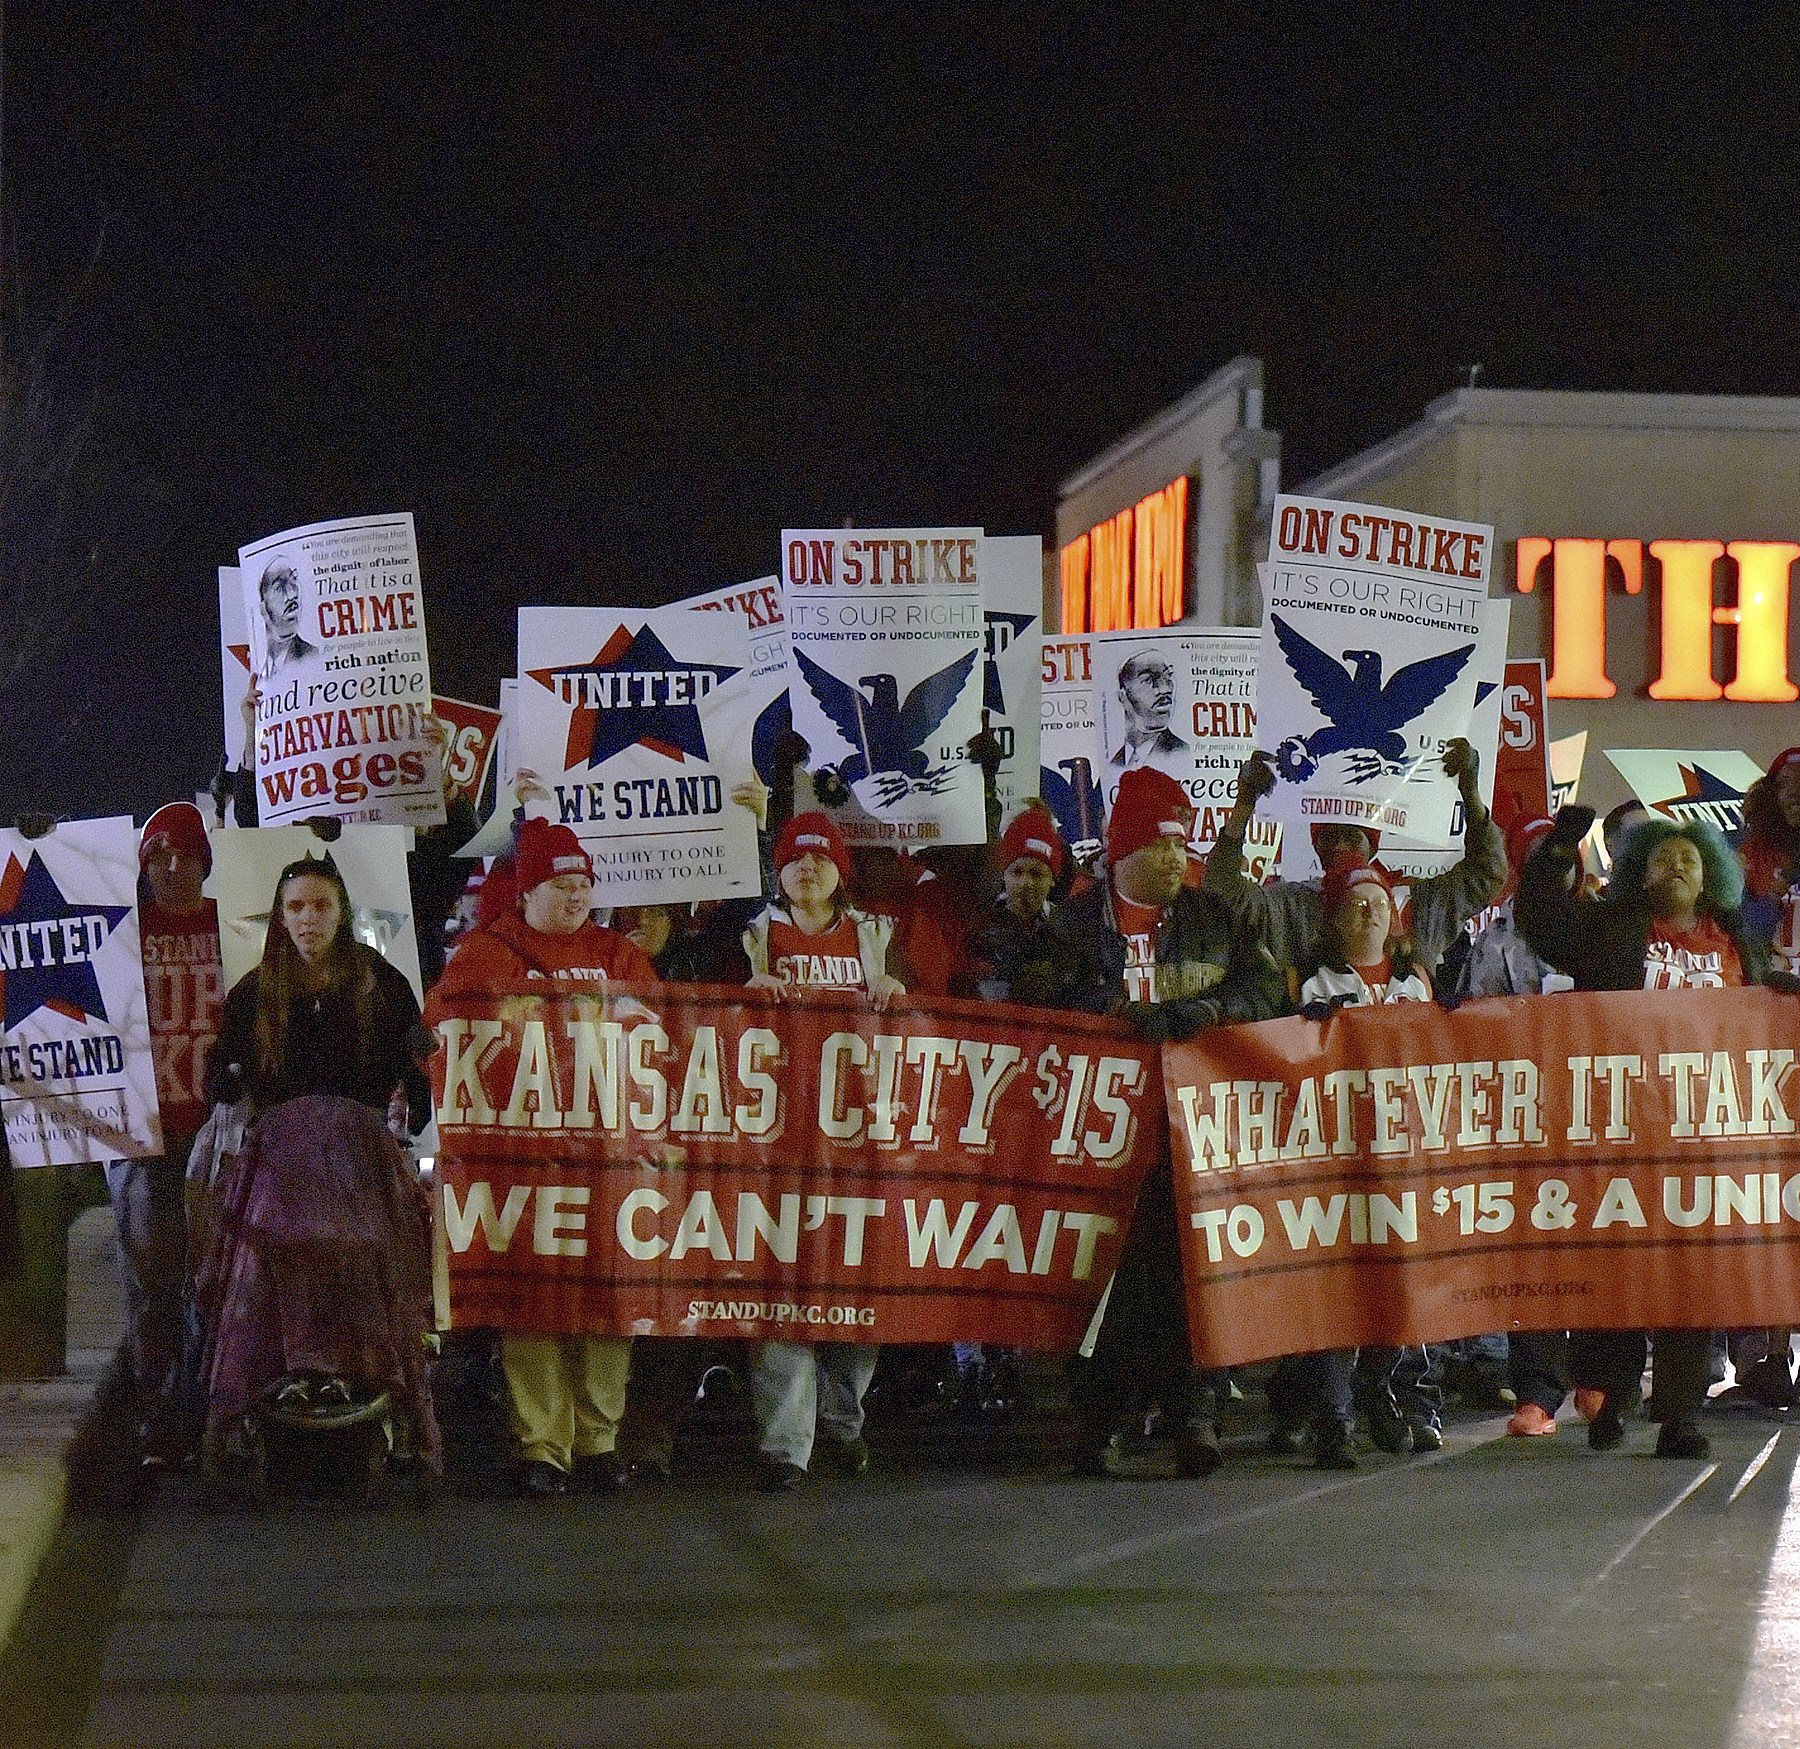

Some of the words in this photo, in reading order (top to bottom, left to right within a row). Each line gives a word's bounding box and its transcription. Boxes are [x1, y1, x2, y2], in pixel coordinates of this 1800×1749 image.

[1278, 506, 1335, 555] ON
[1338, 513, 1485, 580] STRIKE
[313, 564, 331, 576] the
[331, 561, 366, 575] dignit
[369, 557, 383, 568] of
[788, 539, 836, 586] ON
[842, 538, 978, 586] STRIKE
[315, 573, 358, 596] That
[383, 571, 397, 588] is
[402, 572, 412, 585] a
[1272, 570, 1319, 596] IT'S
[1329, 577, 1391, 605] OUR
[1399, 587, 1481, 619] RIGHT
[317, 592, 418, 639] CRIME
[790, 605, 830, 626] IT'S
[839, 605, 898, 627] OUR
[906, 603, 980, 626] RIGHT
[1271, 598, 1357, 614] DOCUMENTED
[1359, 606, 1378, 618] OR
[1380, 611, 1480, 635] UNDOCUMENTED
[791, 631, 868, 642] DOCUMENTED
[870, 630, 887, 641] OR
[890, 629, 980, 641] UNDOCUMENTED
[325, 653, 362, 672] rich
[366, 649, 423, 666] nation
[750, 660, 789, 679] CUMENT
[1190, 667, 1208, 677] the
[1209, 666, 1244, 678] dignity
[1245, 667, 1256, 677] of
[258, 679, 301, 722] and
[308, 666, 425, 707] receive
[550, 669, 719, 710] UNITED
[1192, 678, 1235, 696] That
[1239, 679, 1252, 697] it
[1040, 698, 1089, 719] OUR
[1192, 701, 1258, 739] CRIM
[260, 701, 428, 767] STARVATION
[1194, 754, 1231, 770] rich
[554, 781, 605, 825] WE
[614, 774, 723, 820] STAND
[1301, 797, 1342, 816] STAND
[1345, 800, 1365, 817] UP
[590, 850, 653, 866] INJURY
[658, 848, 683, 862] TO
[688, 845, 727, 860] ONE
[1402, 864, 1423, 877] TO
[1428, 863, 1452, 877] ON
[606, 867, 665, 883] INJURY
[669, 865, 692, 878] TO
[696, 863, 728, 878] ALL
[0, 913, 109, 972] NITED
[776, 953, 864, 986] STAND
[29, 1034, 125, 1083] STAND
[436, 1017, 790, 1142] KANSAS
[816, 1030, 1028, 1153] CITY
[1032, 1043, 1149, 1166] $15
[96, 1104, 129, 1119] ONE
[1176, 1057, 1549, 1176] WHATEVER
[1565, 1053, 1646, 1146] IT
[9, 1131, 28, 1145] AN
[443, 1181, 590, 1260] WE
[615, 1188, 887, 1267] CAN'T
[901, 1197, 1120, 1281] WAIT
[1191, 1204, 1265, 1262] TO
[1275, 1189, 1419, 1251] WIN
[1432, 1179, 1517, 1236] $15
[1530, 1178, 1580, 1232] &
[1591, 1176, 1650, 1229] A
[686, 1299, 877, 1327] STANDUPKC.ORG
